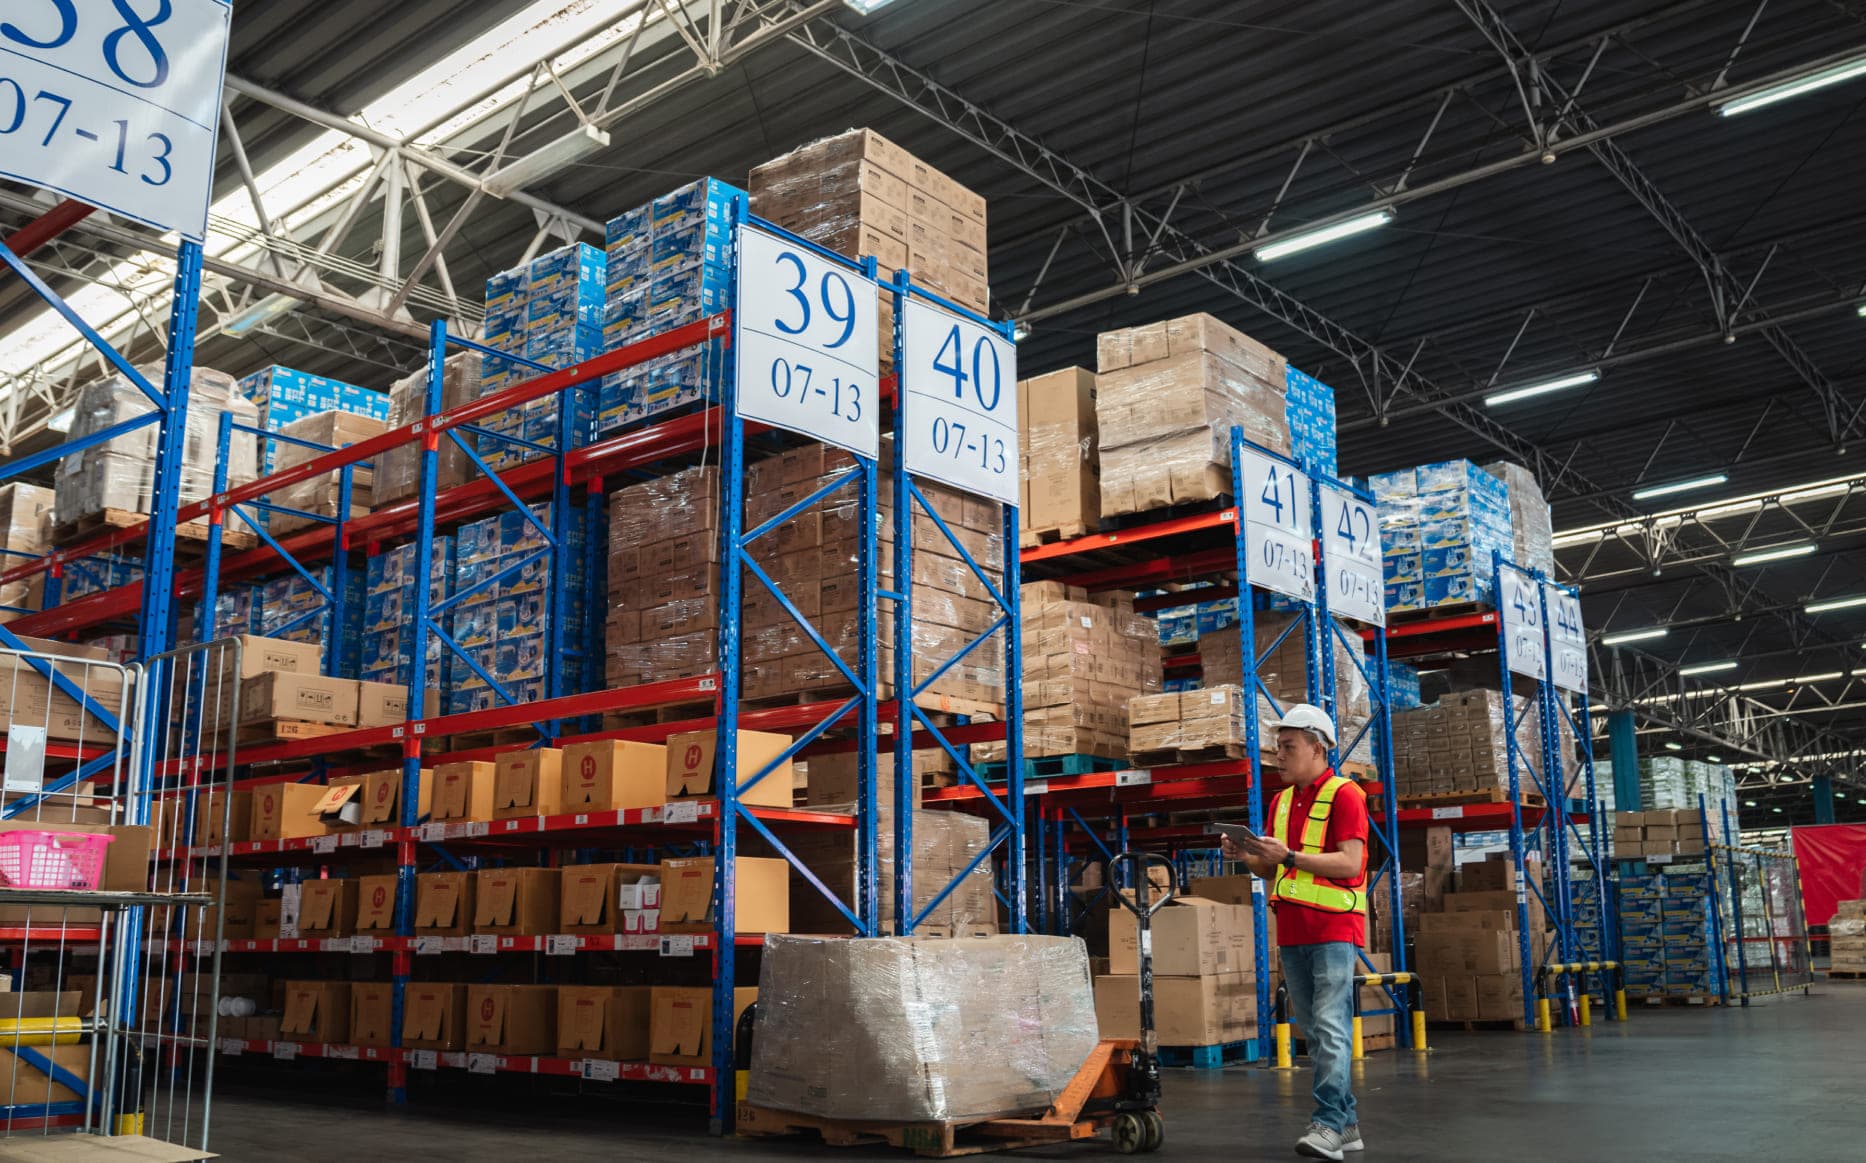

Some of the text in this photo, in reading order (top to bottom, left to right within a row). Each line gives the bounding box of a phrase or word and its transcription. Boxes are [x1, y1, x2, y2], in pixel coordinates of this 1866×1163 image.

[0, 77, 172, 186] 07-13
[775, 252, 856, 348] 39
[771, 357, 862, 422] 07-13
[933, 324, 1001, 411] 40
[932, 417, 1005, 473] 07-13
[1261, 465, 1297, 530] 41
[1263, 539, 1307, 580] 07-13
[1337, 501, 1373, 562] 42
[1340, 569, 1379, 605] 07-13
[1514, 582, 1537, 626] 43
[1558, 598, 1579, 643] 44
